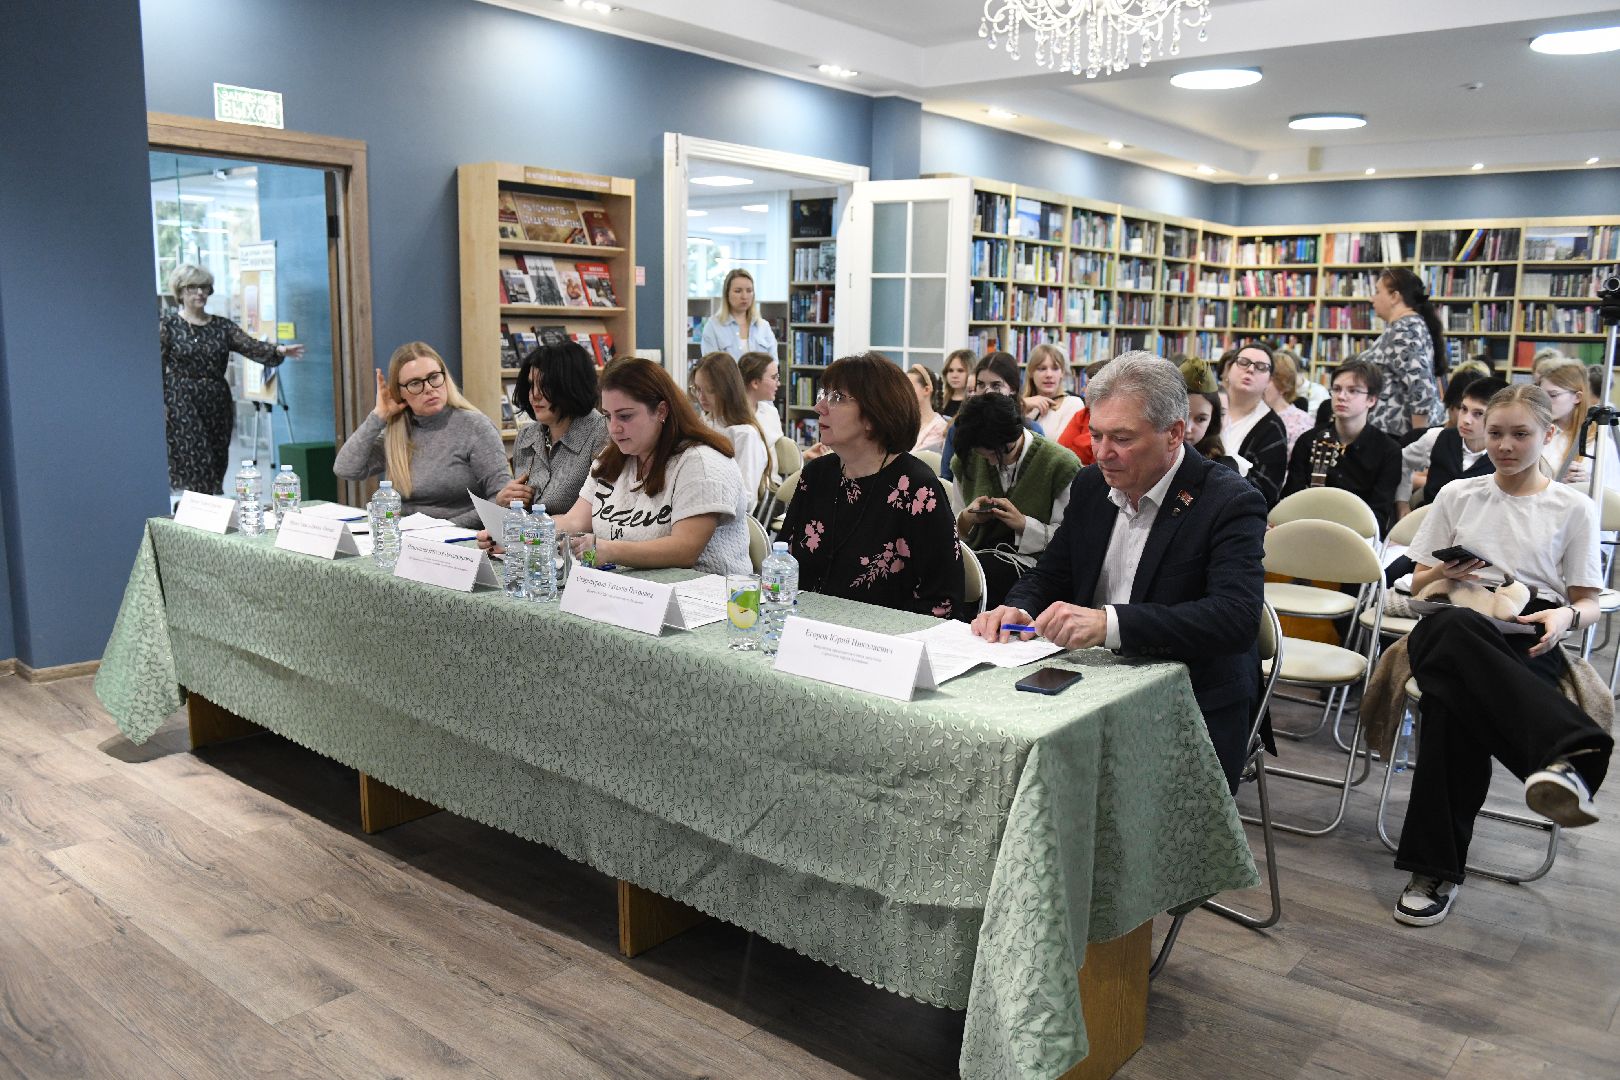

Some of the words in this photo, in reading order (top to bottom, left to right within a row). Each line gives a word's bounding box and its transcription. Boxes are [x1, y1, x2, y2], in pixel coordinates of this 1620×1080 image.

[222, 100, 277, 123] ВЫХОД
[805, 628, 829, 641] Егоров
[829, 633, 850, 645] Юрий
